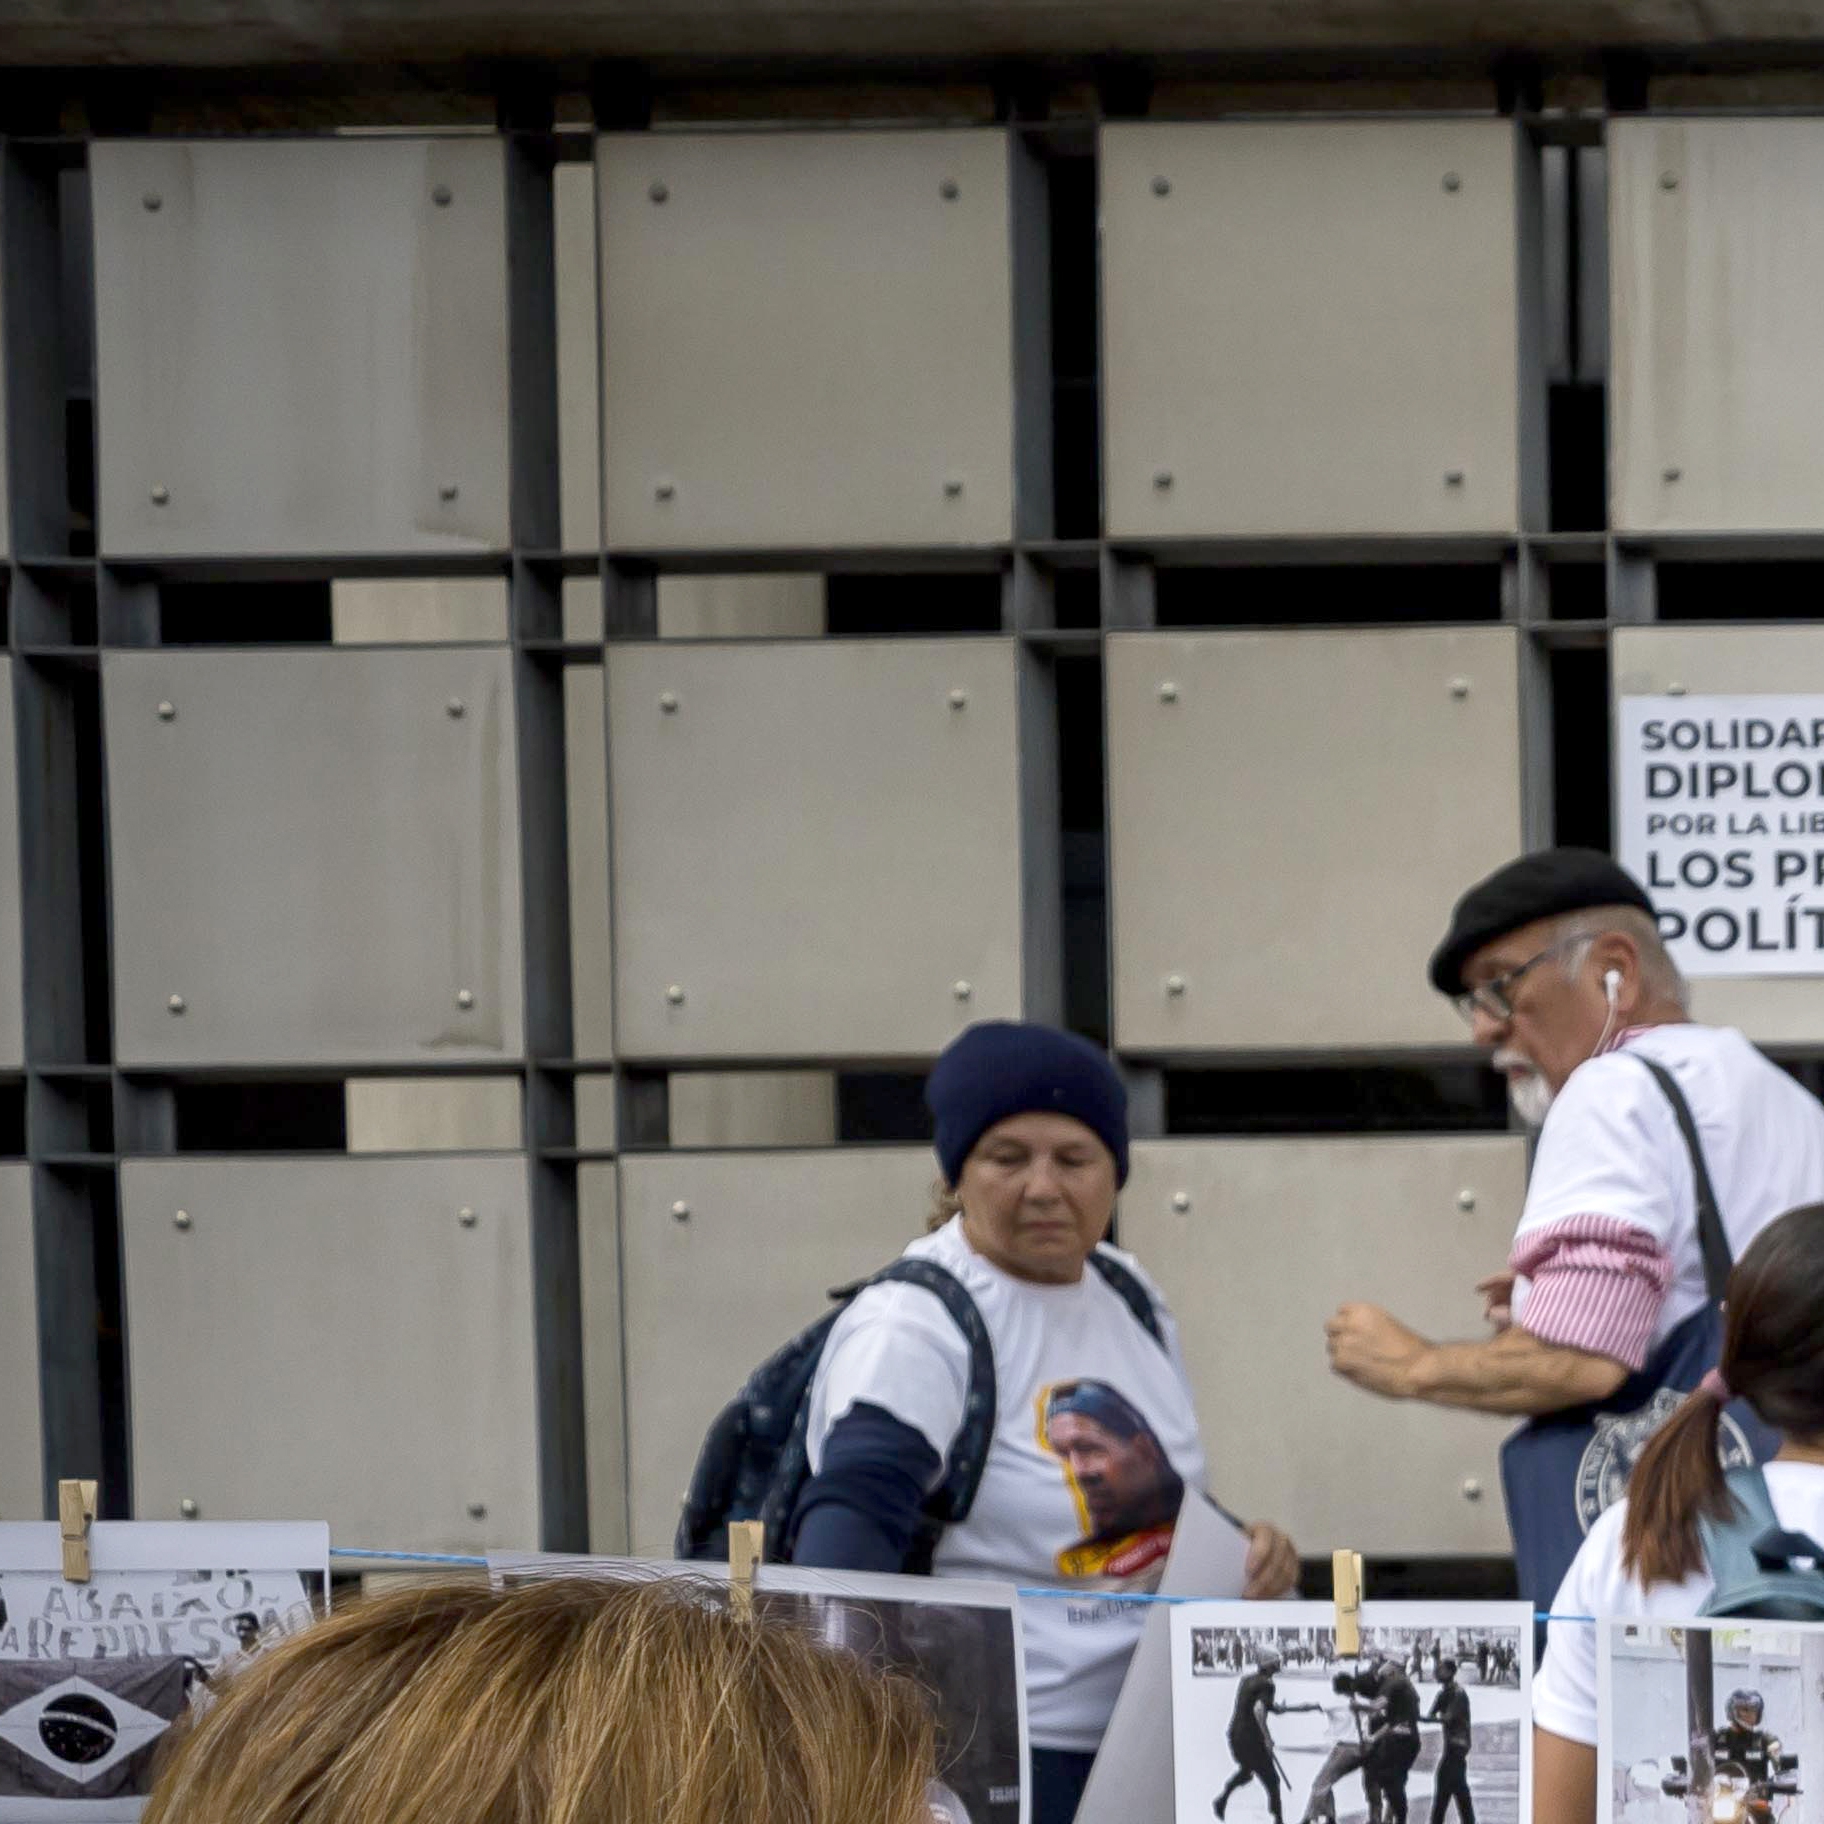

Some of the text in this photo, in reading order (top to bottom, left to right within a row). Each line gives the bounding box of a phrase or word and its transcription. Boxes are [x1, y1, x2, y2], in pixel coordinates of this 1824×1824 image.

[1647, 811, 1718, 837] POR
[1729, 809, 1768, 835] LA
[1648, 851, 1753, 889] LOS
